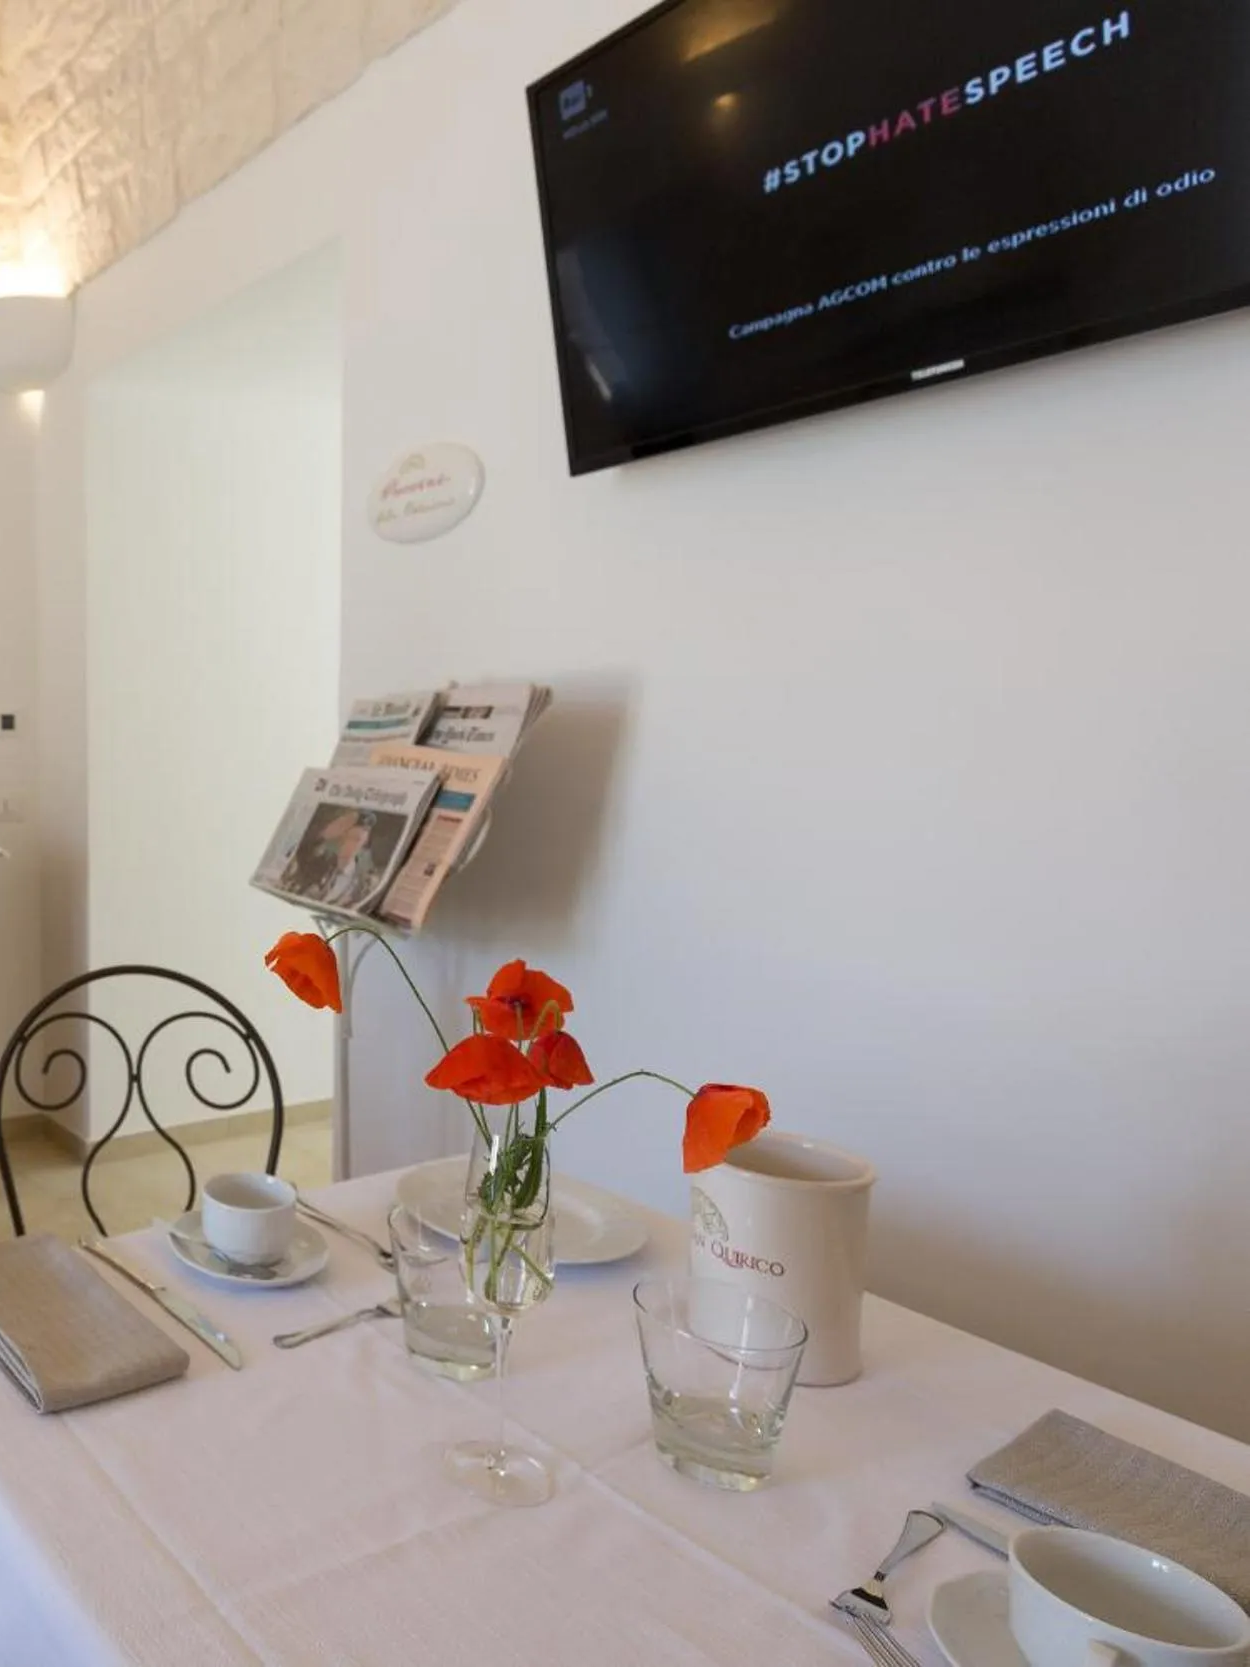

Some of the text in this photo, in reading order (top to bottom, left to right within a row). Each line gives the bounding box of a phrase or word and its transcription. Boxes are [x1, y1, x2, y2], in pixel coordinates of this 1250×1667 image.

[762, 10, 1130, 194] #STOPHATESPEECH
[728, 167, 1216, 340] Campagna AGCOM contro le espressioni di odio
[711, 1239, 784, 1277] QUIRICO
